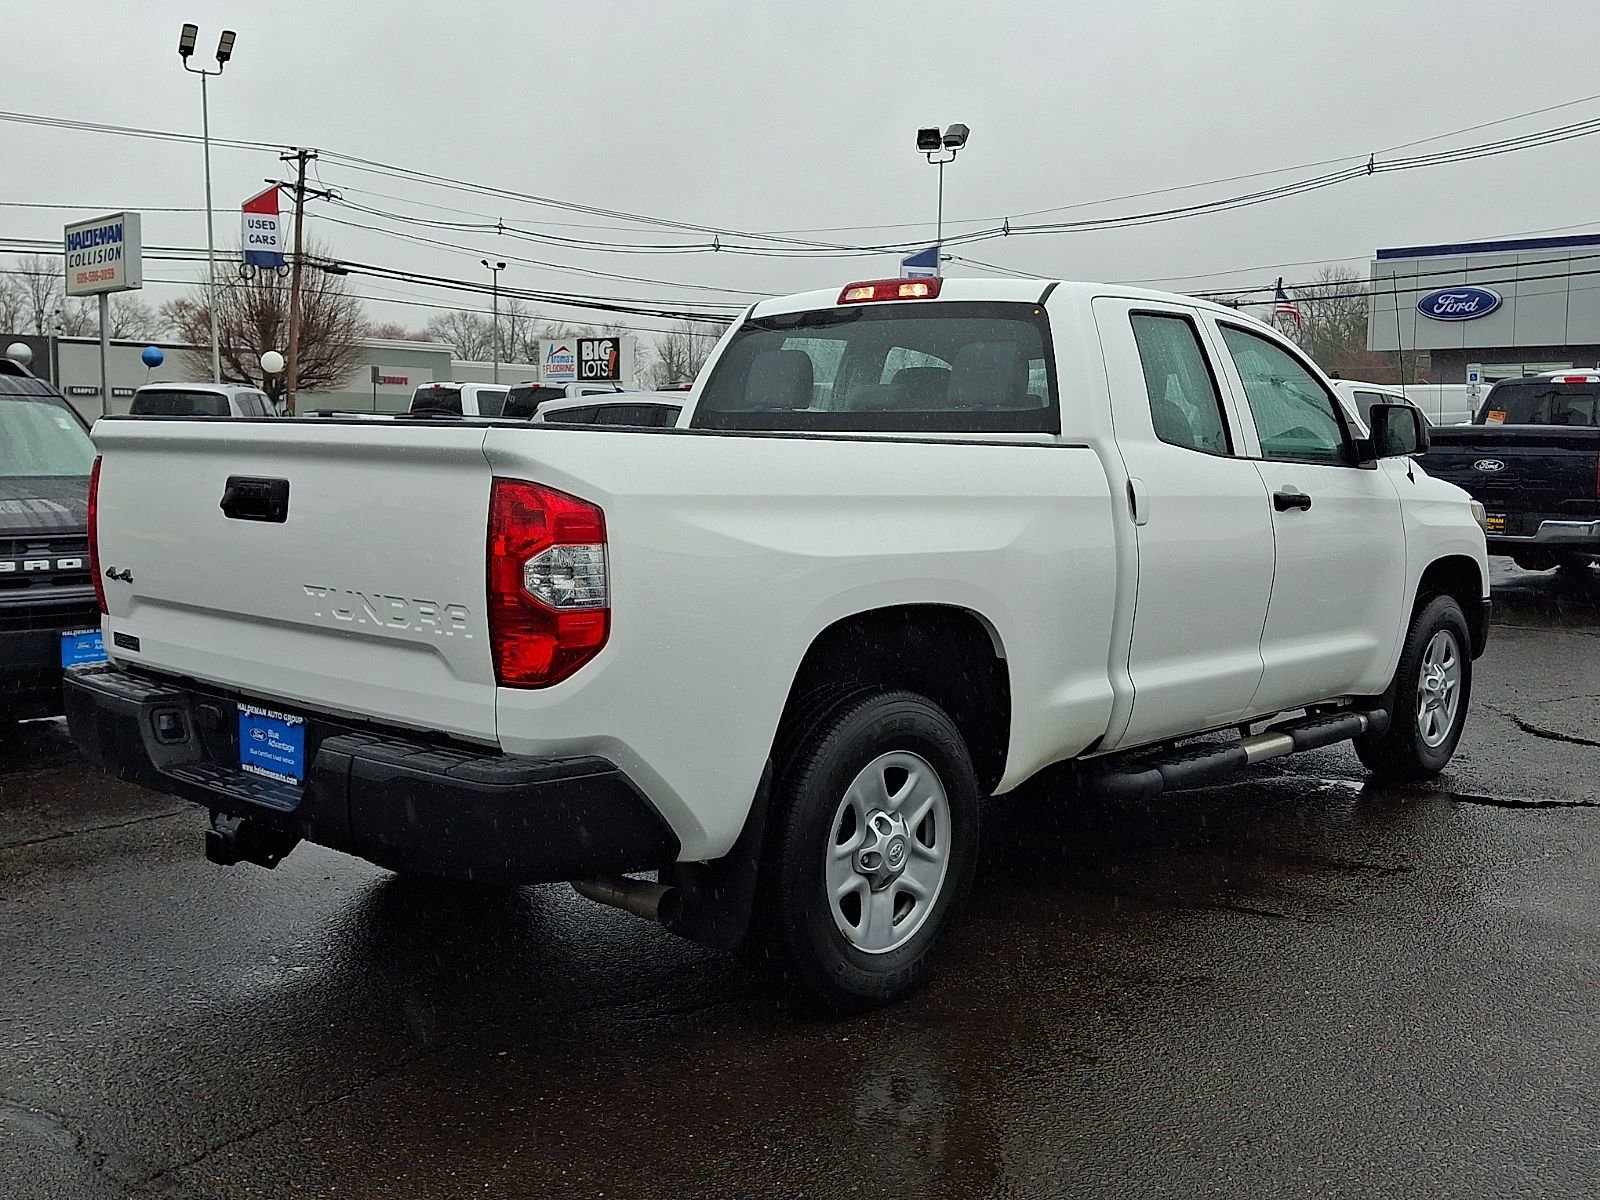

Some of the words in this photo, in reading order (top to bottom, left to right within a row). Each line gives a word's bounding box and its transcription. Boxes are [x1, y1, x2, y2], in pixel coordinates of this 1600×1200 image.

[247, 219, 276, 231] USED
[67, 223, 123, 252] HALDEMAN
[248, 234, 277, 246] CARS
[69, 245, 122, 268] COLLISION
[1433, 293, 1480, 314] Ford
[581, 340, 614, 360] BIG
[545, 364, 575, 373] FLOORING
[1478, 459, 1500, 470] Ford
[303, 584, 474, 639] TUNDRA
[237, 702, 267, 716] HALDEMAN
[267, 709, 283, 720] AUTO
[283, 713, 304, 725] GROUP
[267, 729, 280, 740] Blue
[267, 739, 295, 753] Advantage
